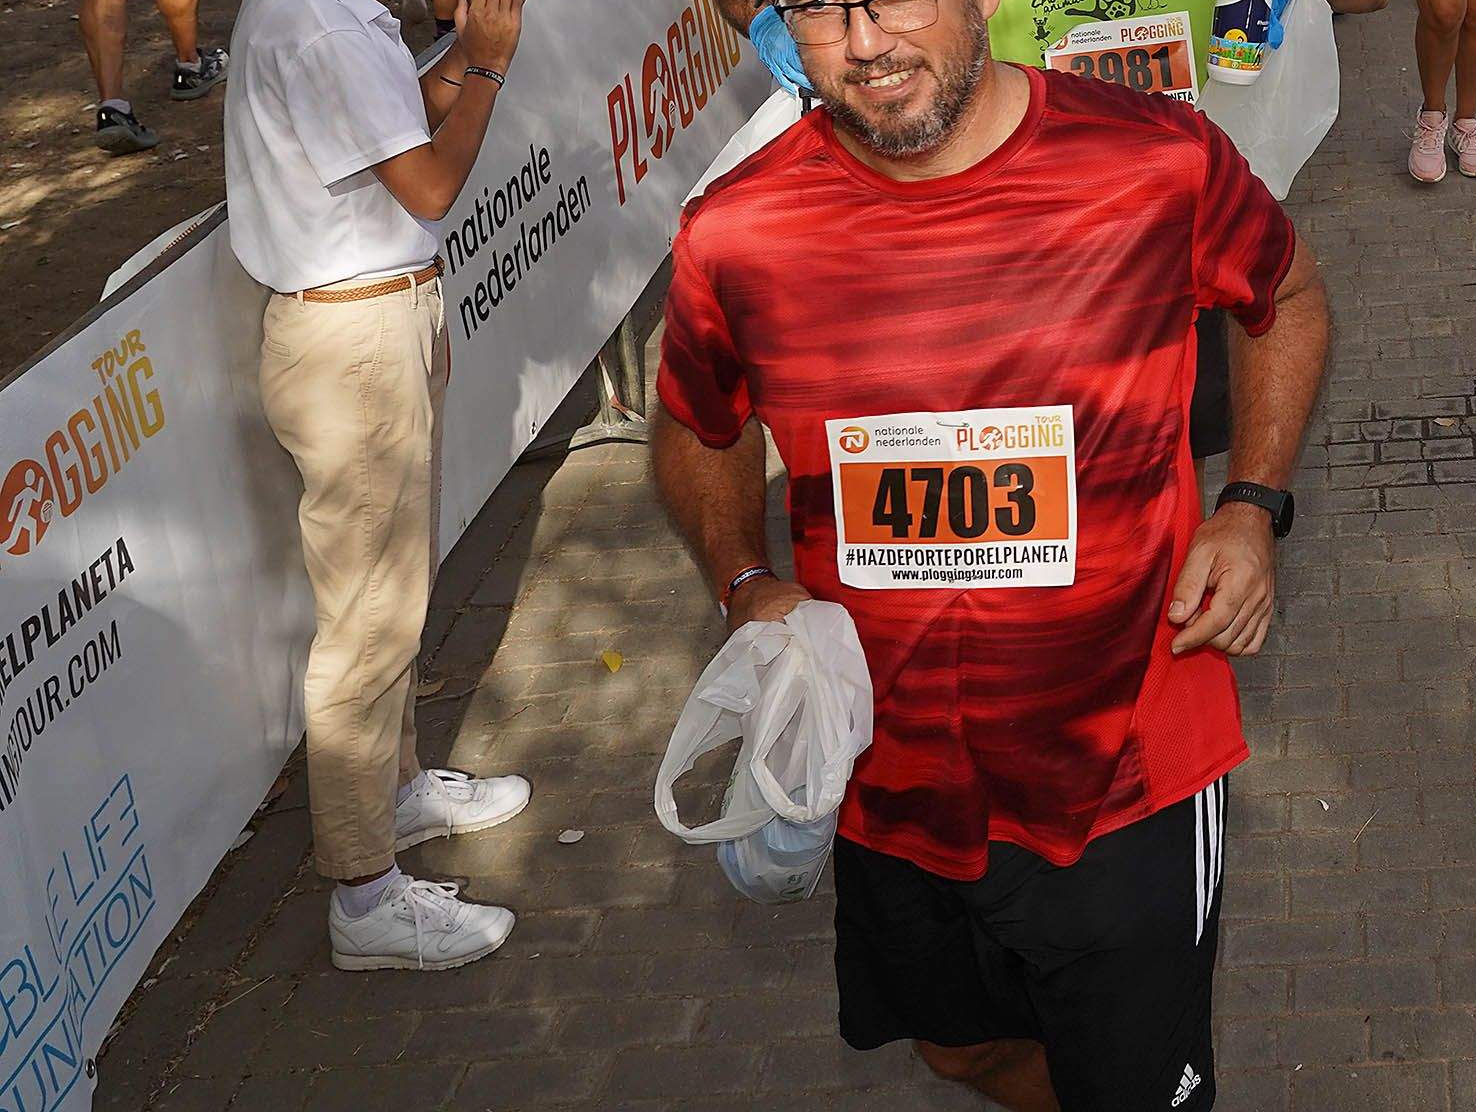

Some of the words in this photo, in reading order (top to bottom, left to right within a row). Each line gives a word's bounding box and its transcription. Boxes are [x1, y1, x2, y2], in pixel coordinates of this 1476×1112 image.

[1070, 28, 1101, 38] nationale
[1071, 33, 1113, 45] nederlanden
[1120, 22, 1185, 43] PLOGGING
[1070, 45, 1173, 94] 3981
[445, 143, 552, 276] nationale
[459, 174, 592, 340] nederlanden
[91, 328, 146, 385] TOUR
[1035, 415, 1062, 424] TOUR
[875, 426, 924, 436] nationale
[875, 437, 941, 447] nederlanden
[957, 424, 1064, 452] PLOGGING
[872, 462, 1036, 539] 4703
[845, 544, 1068, 567] #HAZDEPORTEPORELPLANETA
[891, 567, 1023, 583] www.ploggingtour.com
